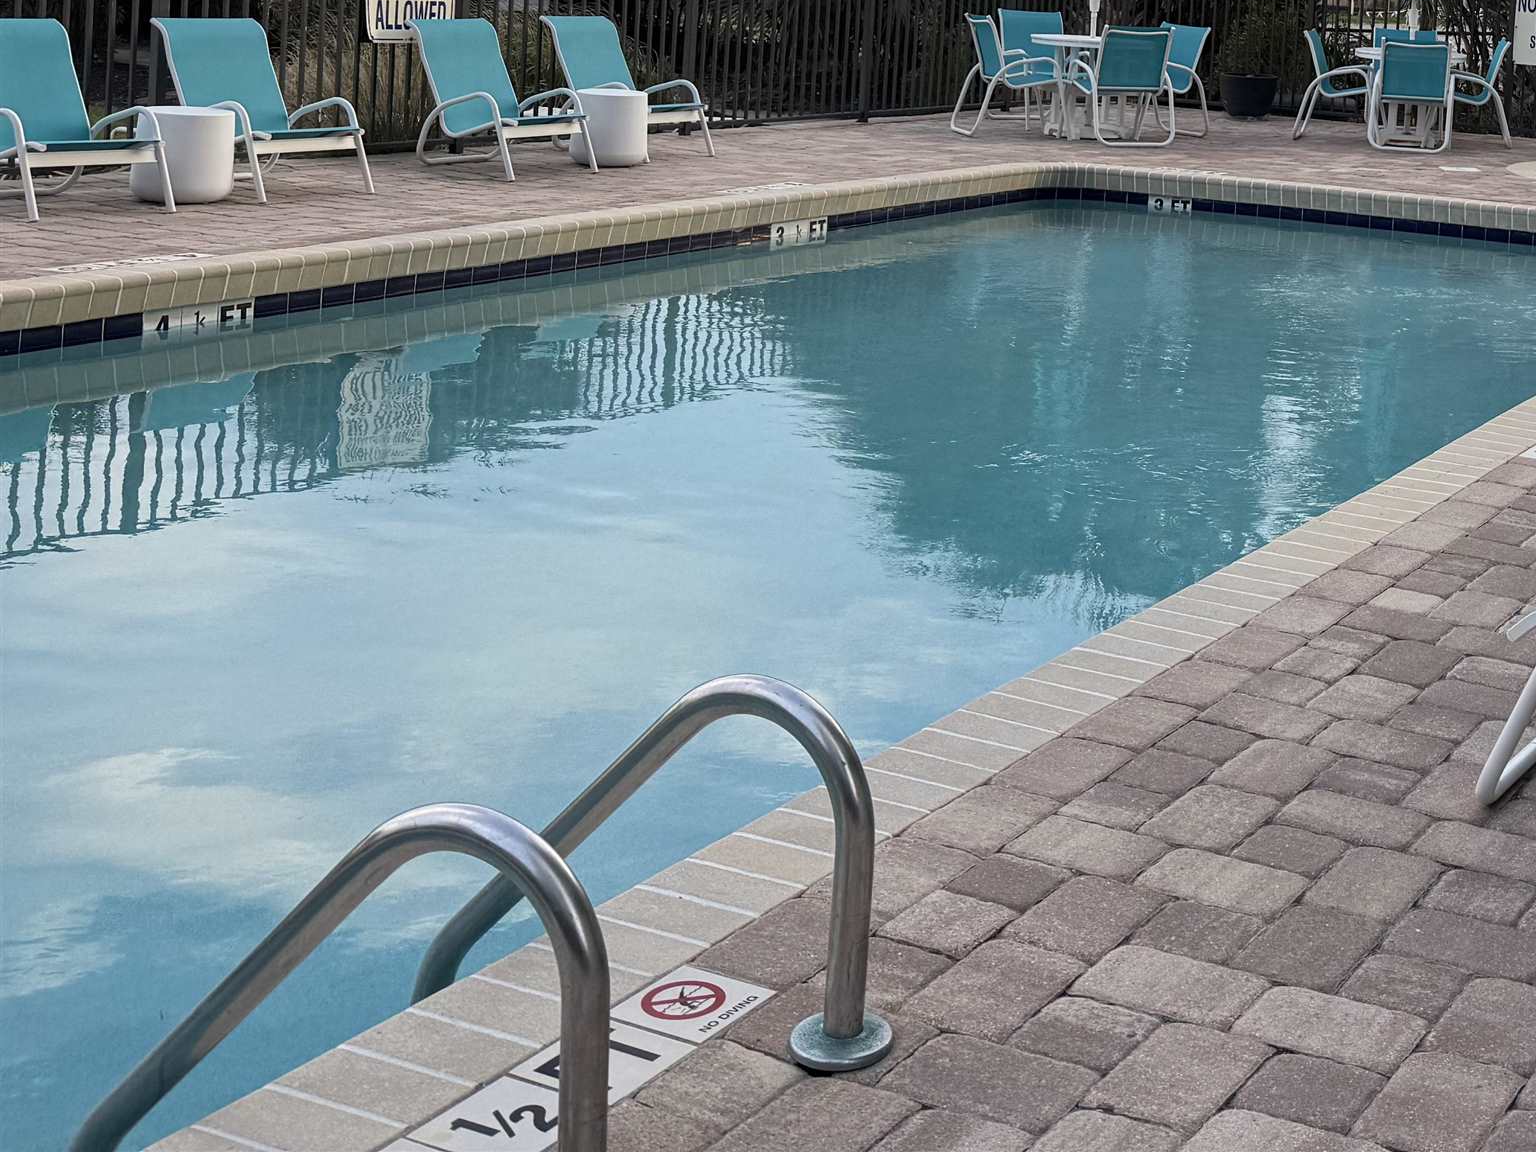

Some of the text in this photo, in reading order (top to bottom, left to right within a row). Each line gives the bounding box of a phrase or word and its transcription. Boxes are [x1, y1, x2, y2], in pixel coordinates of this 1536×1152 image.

[375, 0, 447, 30] ALLOWED
[698, 995, 759, 1033] NO DIVING
